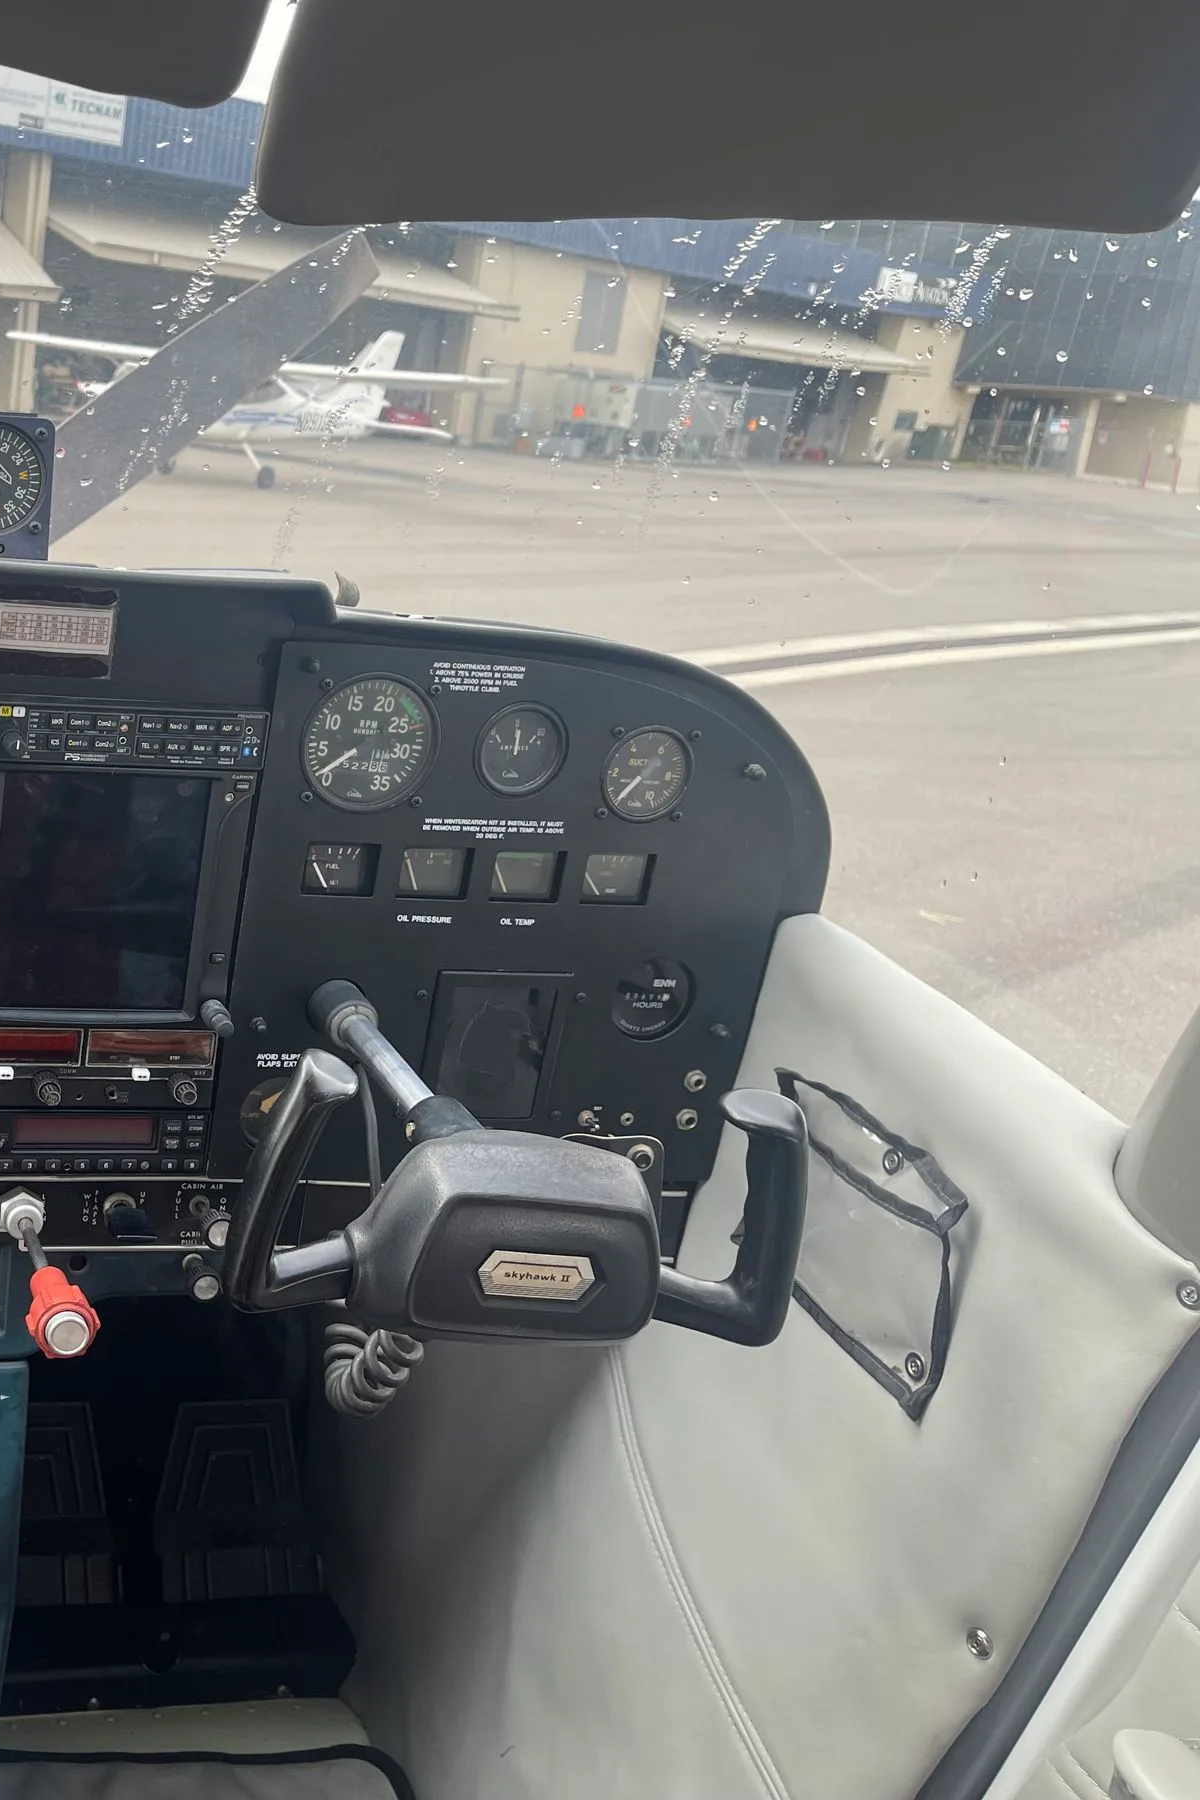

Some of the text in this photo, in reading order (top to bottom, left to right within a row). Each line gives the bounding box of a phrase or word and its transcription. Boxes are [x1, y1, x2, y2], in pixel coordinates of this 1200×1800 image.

[0, 442, 10, 453] 21
[11, 453, 24, 465] 24
[18, 470, 28, 480] W
[14, 486, 26, 499] 30
[3, 500, 16, 513] 33
[348, 696, 363, 711] 15
[373, 696, 394, 712] 20
[325, 714, 341, 730] 10
[360, 720, 378, 728] RPM
[388, 717, 409, 733] 25
[317, 741, 328, 756] 5
[391, 743, 410, 759] 30
[322, 772, 332, 786] 0
[370, 775, 391, 791] 35
[412, 915, 452, 924] PRESSURE
[653, 979, 676, 988] ENM
[140, 1192, 146, 1205] UP
[220, 1197, 226, 1211] ON
[83, 1193, 91, 1222] WING
[504, 1271, 570, 1282] skyhawk II
